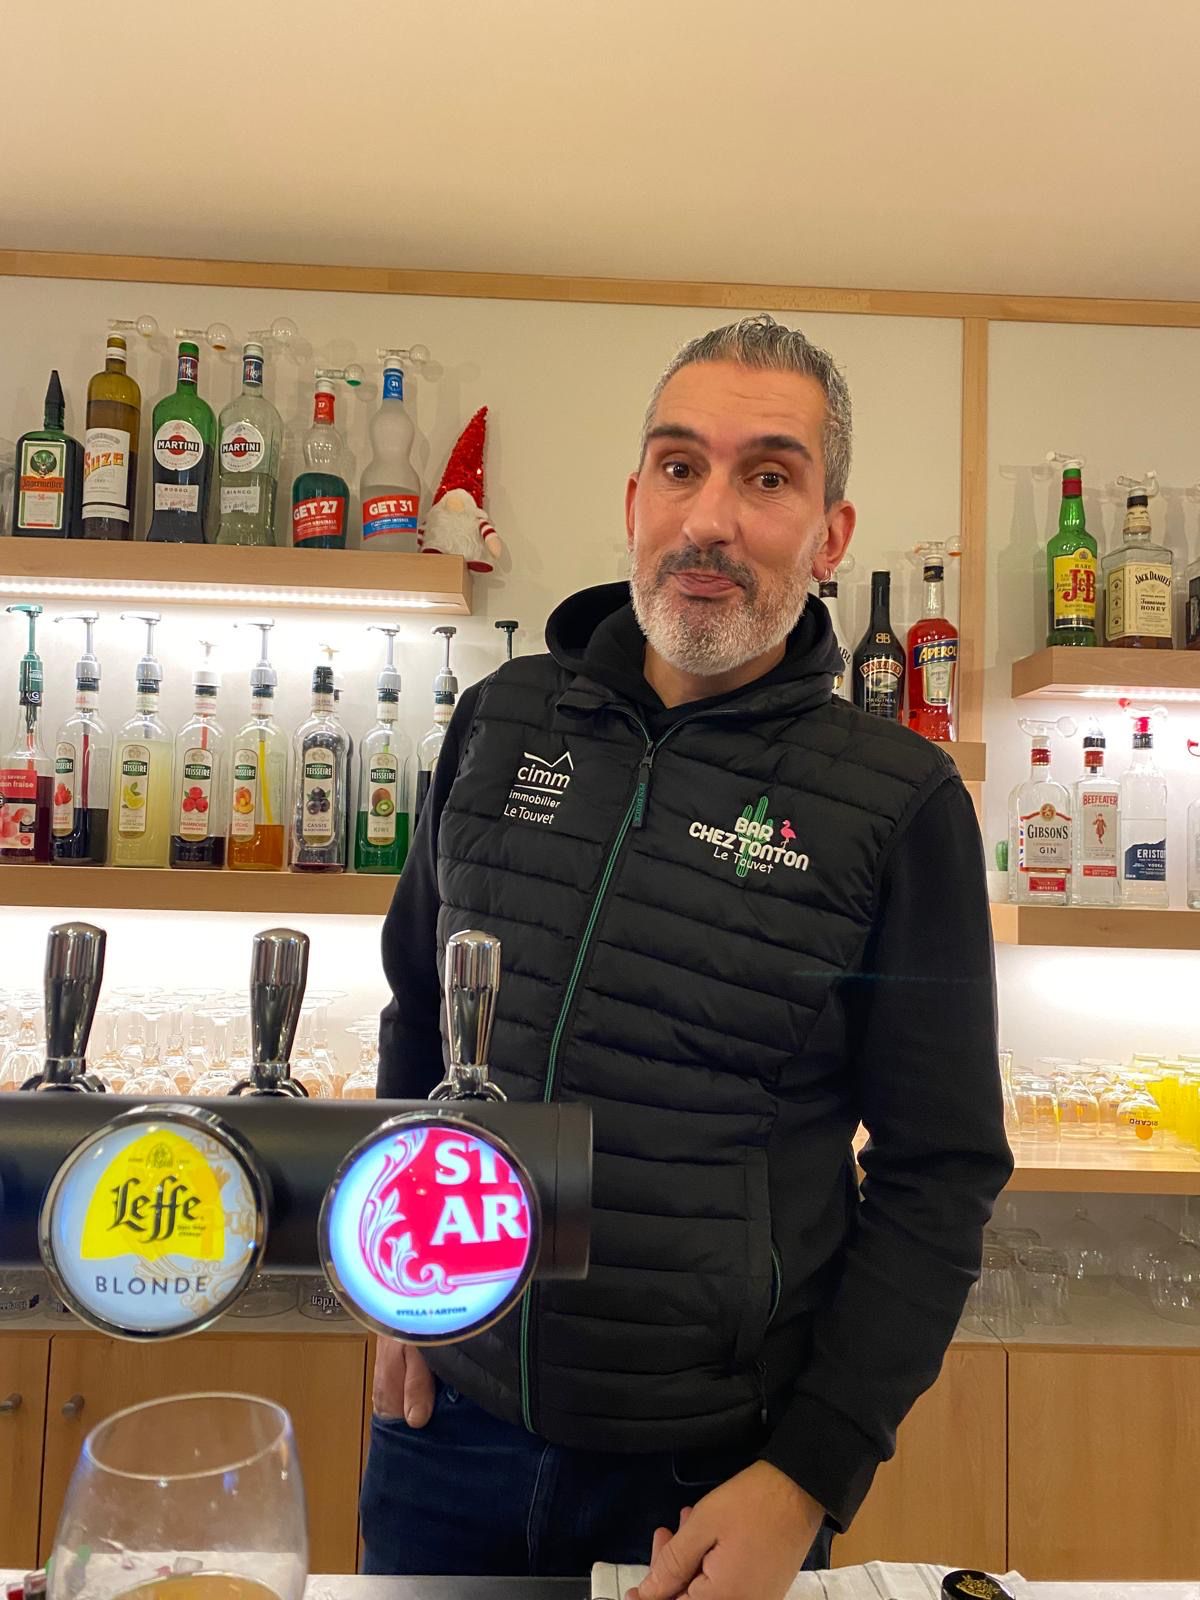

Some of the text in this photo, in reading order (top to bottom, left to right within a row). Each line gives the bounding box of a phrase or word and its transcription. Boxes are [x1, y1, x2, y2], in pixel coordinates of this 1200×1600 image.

[158, 440, 199, 451] MARTINI
[222, 443, 259, 453] MARTINI
[294, 501, 318, 521] GET
[321, 500, 337, 514] 27
[369, 500, 413, 514] GET 31
[1135, 574, 1149, 584] JACK
[862, 659, 901, 676] BAILEYS
[306, 768, 332, 776] TEISSEIRE
[517, 764, 571, 788] cimm
[13, 780, 34, 788] fraise
[508, 789, 561, 808] immobilier
[1082, 795, 1118, 806] BEEFEATER
[503, 803, 555, 825] Le Touvet
[734, 816, 774, 842] BAR
[1028, 824, 1069, 840] GIBSON'S
[688, 822, 810, 872] CHEZ TONTON
[714, 846, 775, 875] Le Touvet
[1130, 1118, 1158, 1127] RICARD
[107, 1174, 202, 1244] Leffe
[429, 1193, 527, 1246] AR
[95, 1276, 209, 1296] BLONDE
[396, 1306, 468, 1317] STELLA ARTOIS
